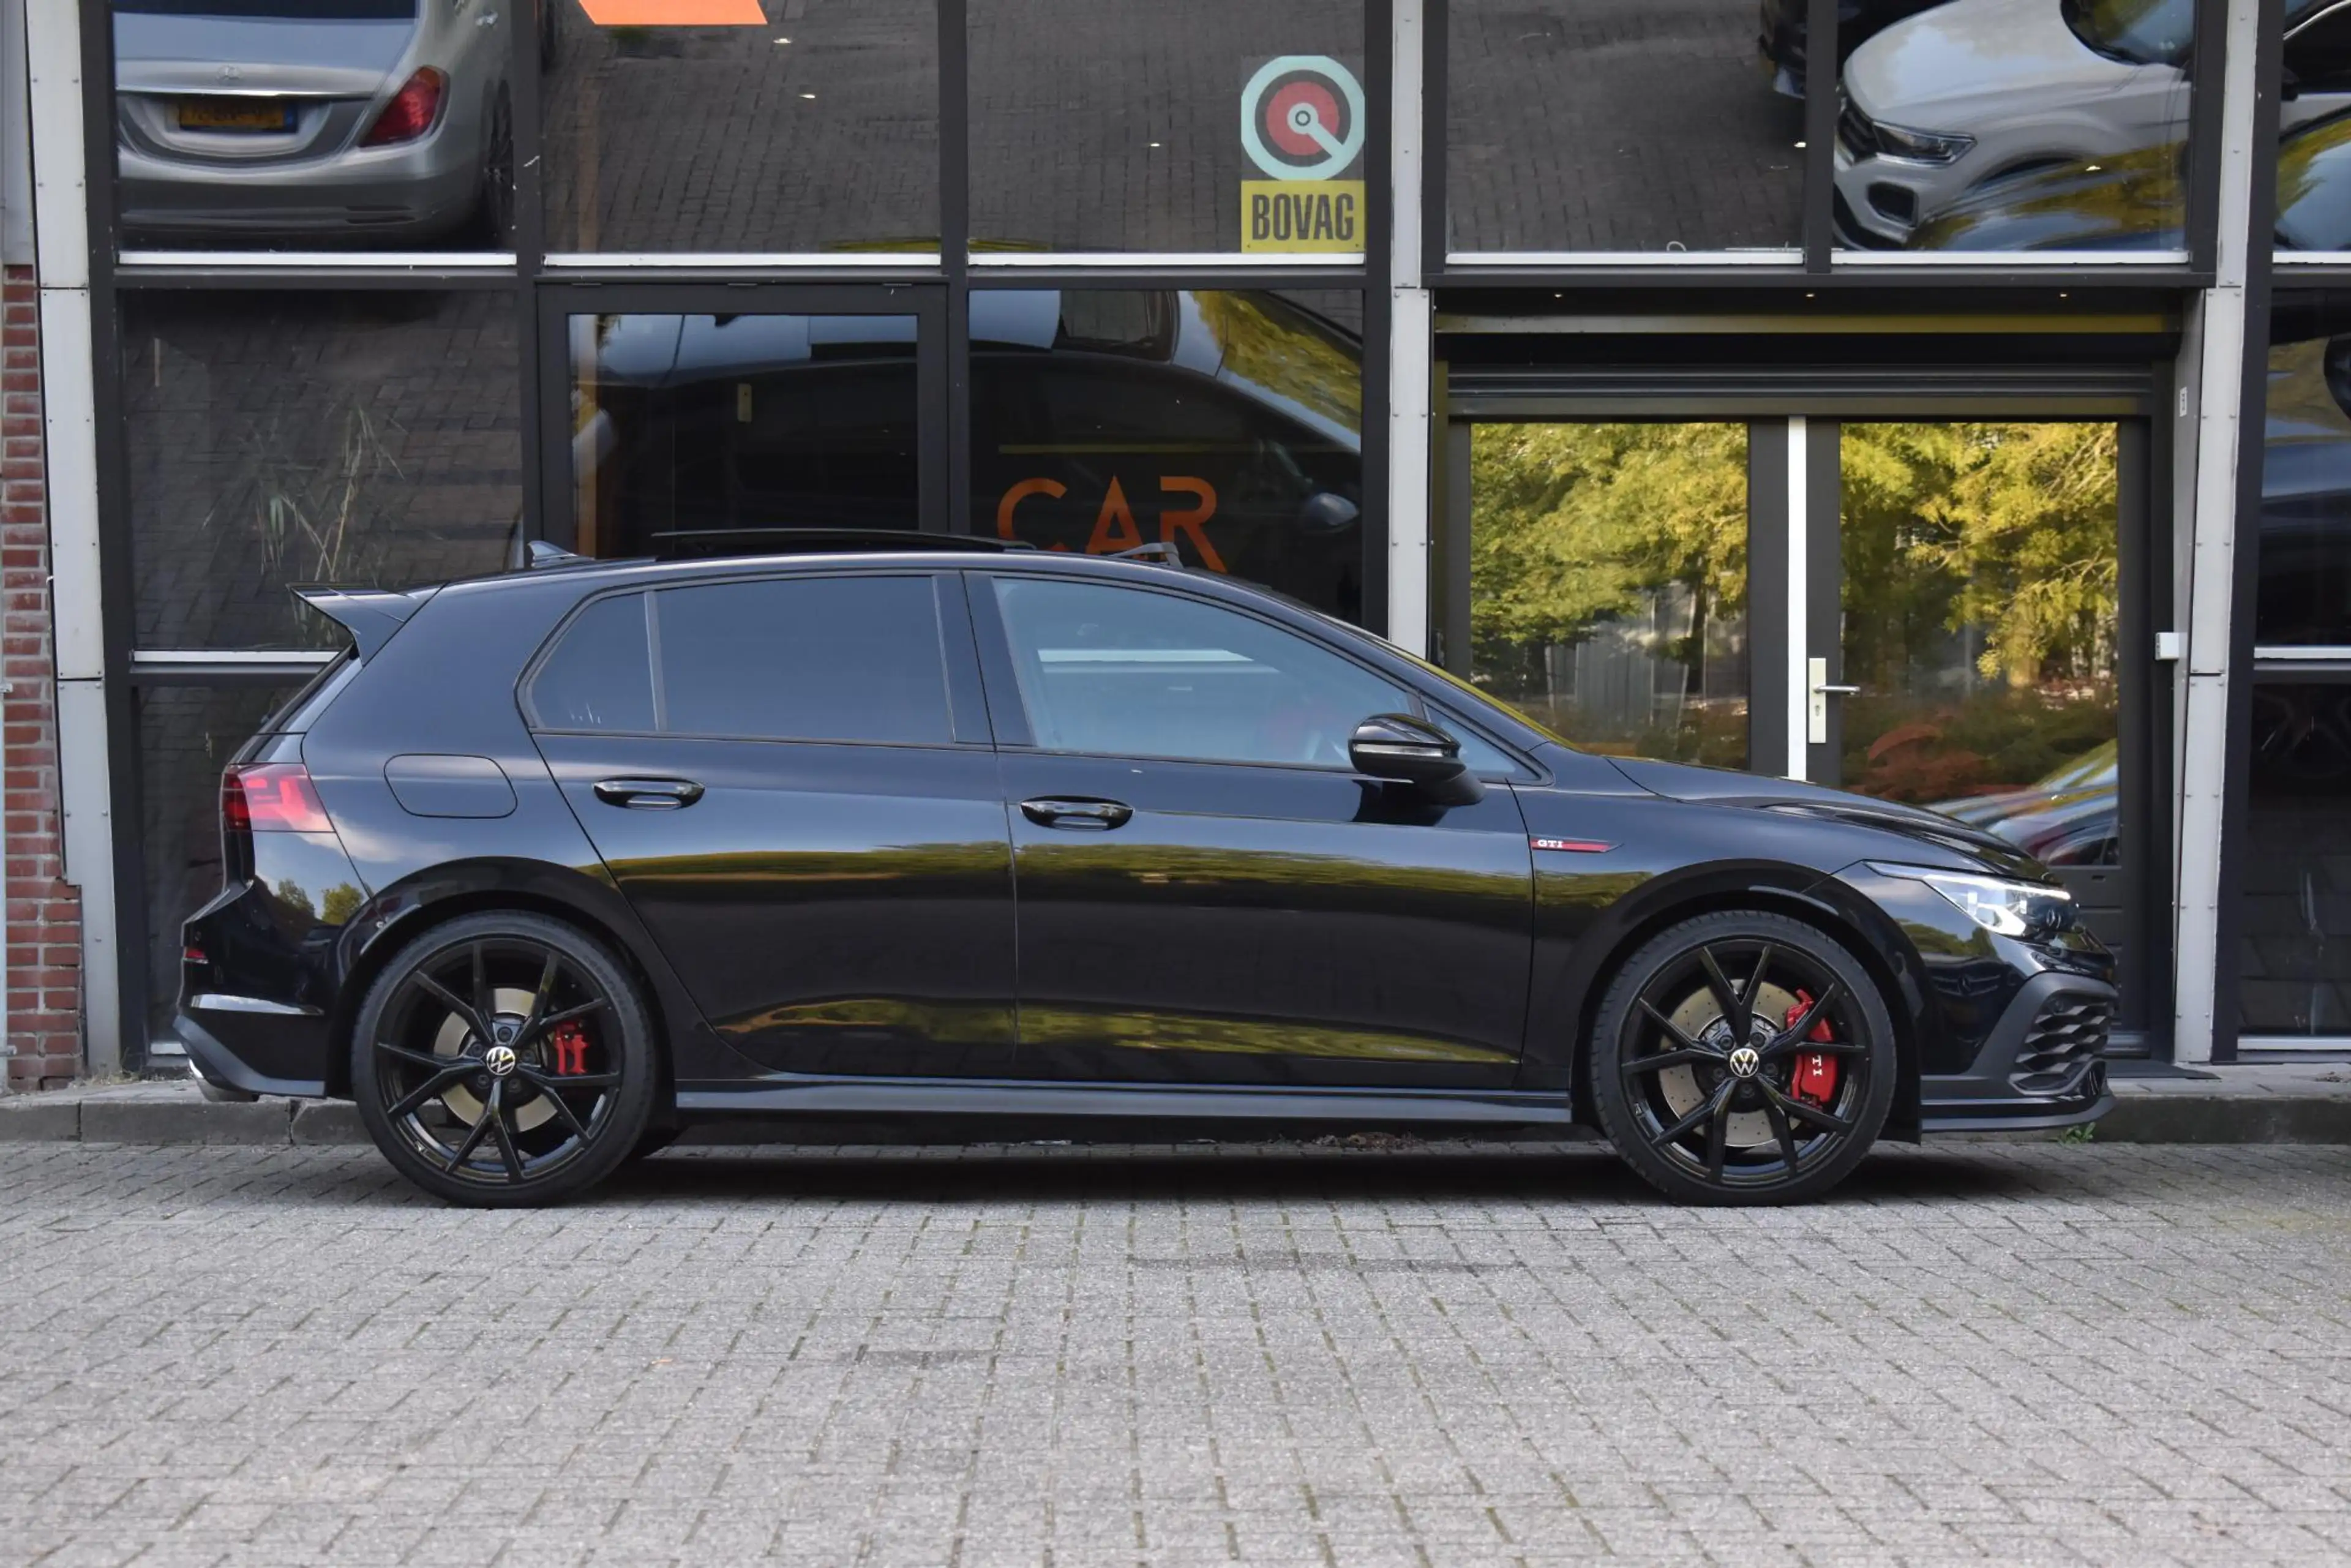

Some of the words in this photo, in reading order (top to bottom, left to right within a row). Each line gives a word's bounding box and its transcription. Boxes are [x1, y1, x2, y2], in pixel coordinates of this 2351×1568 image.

[1252, 193, 1354, 240] BOVAG
[997, 475, 1228, 573] CAR
[1537, 839, 1564, 849] GTI
[1812, 1054, 1823, 1076] TI
